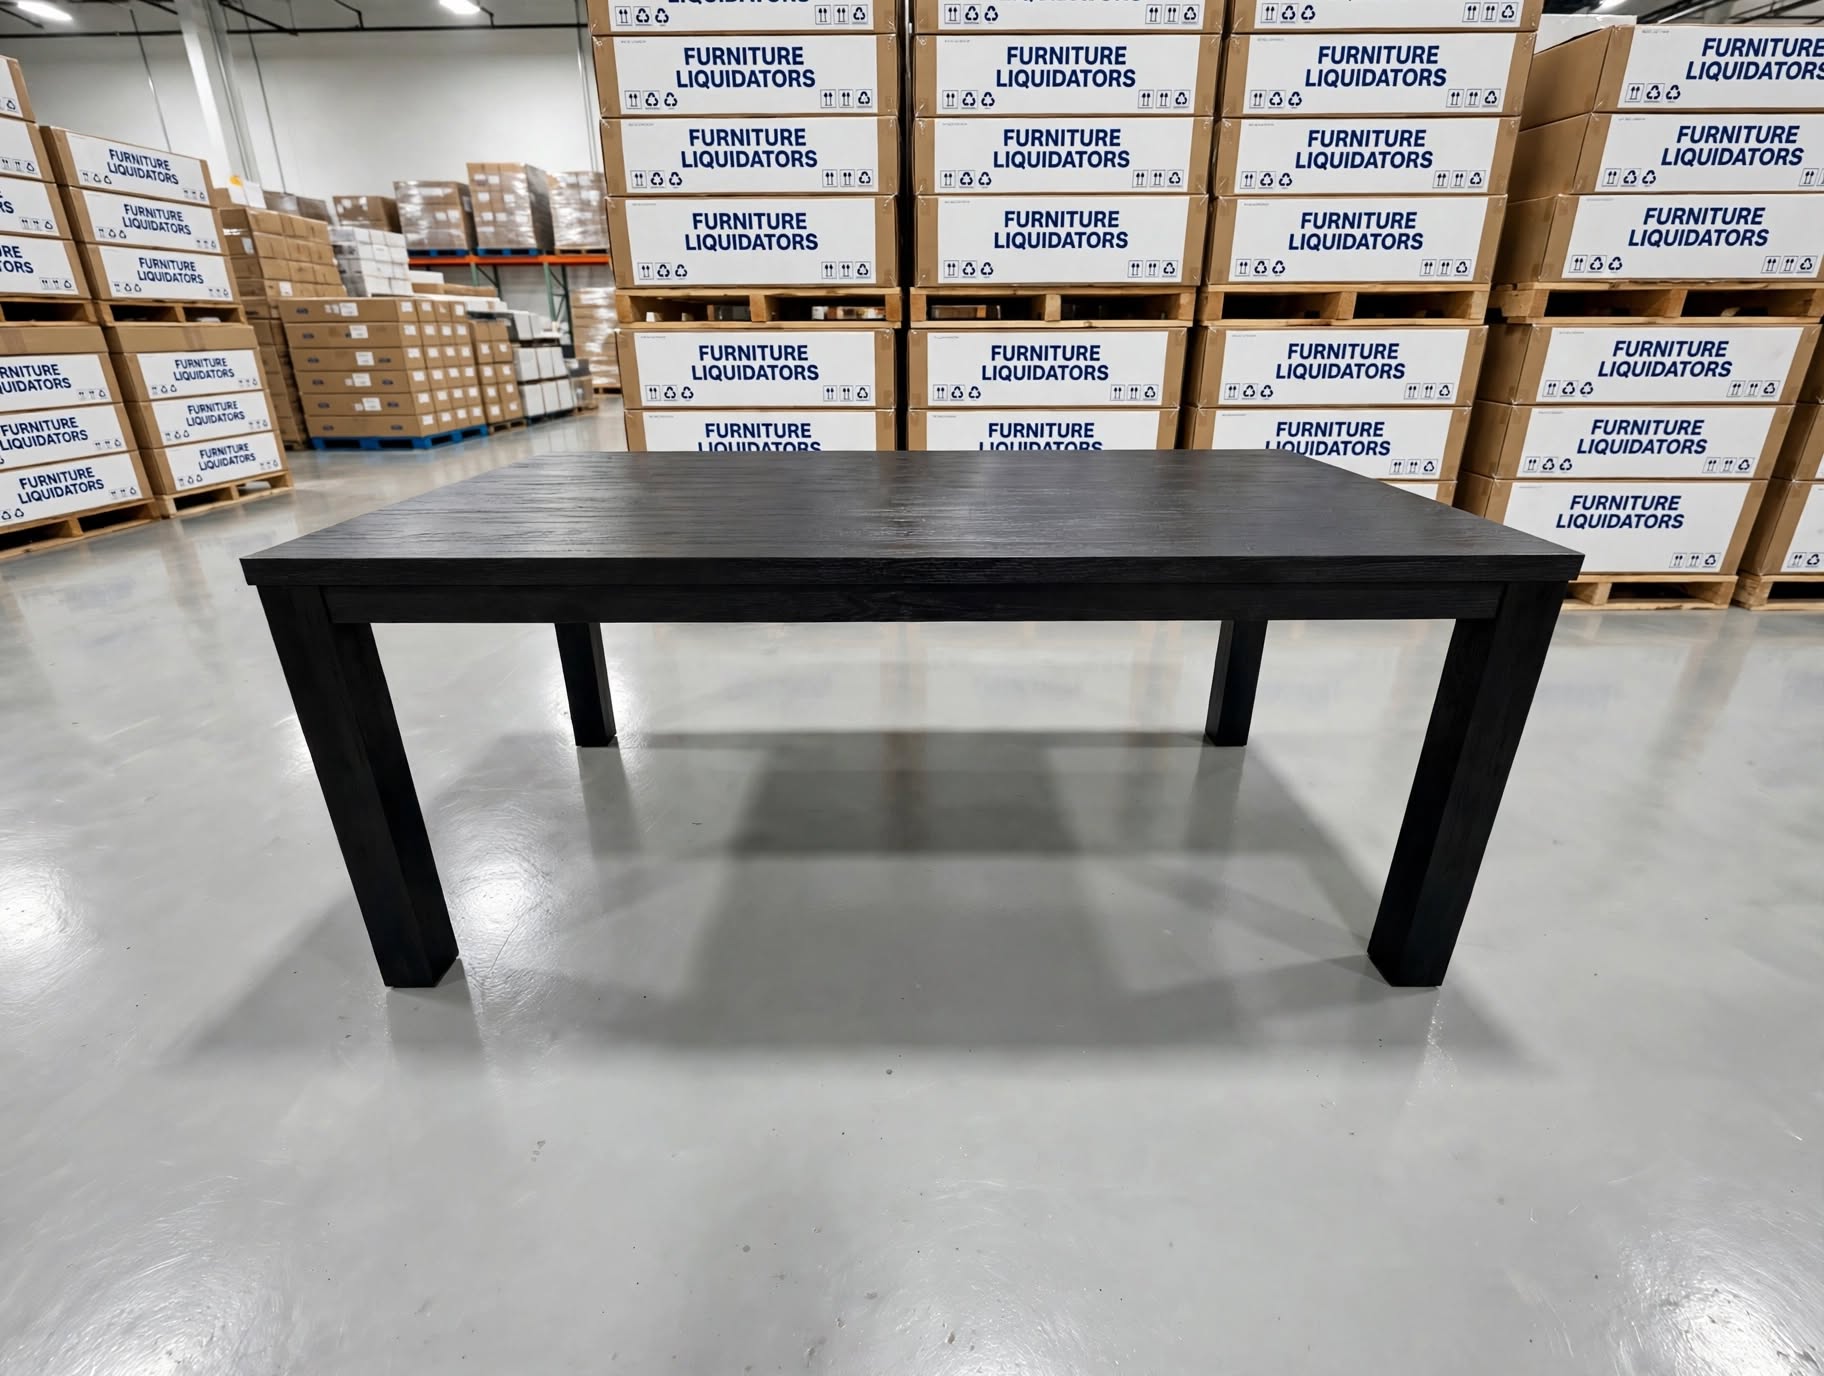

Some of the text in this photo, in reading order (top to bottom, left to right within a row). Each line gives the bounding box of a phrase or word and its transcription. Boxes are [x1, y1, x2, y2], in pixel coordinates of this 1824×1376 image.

[684, 47, 802, 65] FURNITURE
[1007, 46, 1126, 65] FURNITURE
[1318, 45, 1439, 64] FURNITURE
[1702, 38, 1824, 57] FURNITURE
[676, 69, 815, 88] LIQUIDATORS
[997, 69, 1135, 88] LIQUIDATORS
[1305, 68, 1446, 88] LIQUIDATORS
[689, 128, 806, 146] FURNITURE
[1004, 129, 1120, 147] FURNITURE
[1308, 130, 1424, 147] FURNITURE
[1677, 126, 1799, 144] FURNITURE
[109, 149, 171, 171] FURNITURE
[681, 150, 817, 168] LIQUIDATORS
[994, 150, 1129, 169] LIQUIDATORS
[1296, 151, 1432, 169] LIQUIDATORS
[1661, 148, 1803, 166] LIQUIDATORS
[107, 162, 179, 185] LIQUIDATORS
[123, 204, 184, 222] FURNITURE
[692, 213, 807, 230] FURNITURE
[1005, 211, 1119, 228] FURNITURE
[1301, 212, 1416, 229] FURNITURE
[1643, 207, 1764, 225] FURNITURE
[122, 216, 192, 235] LIQUIDATORS
[685, 233, 818, 251] LIQUIDATORS
[994, 231, 1128, 250] LIQUIDATORS
[1289, 233, 1423, 251] LIQUIDATORS
[1628, 229, 1768, 247] LIQUIDATORS
[138, 257, 196, 272] FURNITURE
[137, 270, 204, 285] LIQUIDATORS
[699, 345, 808, 361] FURNITURE
[992, 345, 1100, 361] FURNITURE
[1288, 343, 1398, 360] FURNITURE
[1613, 341, 1728, 357] FURNITURE
[0, 364, 61, 379] RNITURE
[174, 358, 228, 369] FURNITURE
[692, 365, 819, 380] LIQUIDATORS
[1276, 363, 1405, 380] LIQUIDATORS
[1598, 361, 1732, 377] LIQUIDATORS
[173, 368, 235, 381] LIQUIDATORS
[982, 365, 1108, 382] LIQUIDATORS
[187, 401, 239, 415] FURNITURE
[0, 417, 79, 437] FURNITURE
[186, 411, 246, 427] LIQUIDATORS
[1592, 419, 1703, 435] FURNITURE
[705, 423, 811, 438] FURNITURE
[989, 423, 1094, 438] FURNITURE
[1276, 422, 1384, 437] FURNITURE
[0, 430, 88, 451] LIQUIDATORS
[1577, 439, 1707, 454] LIQUIDATORS
[199, 443, 250, 459] FURNITURE
[198, 453, 256, 471] LIQUIDATORS
[19, 467, 95, 489] FURNITURE
[18, 479, 104, 504] LIQUIDATORS
[1571, 496, 1680, 510] FURNITURE
[1556, 514, 1683, 528] LIQUIDATORS
